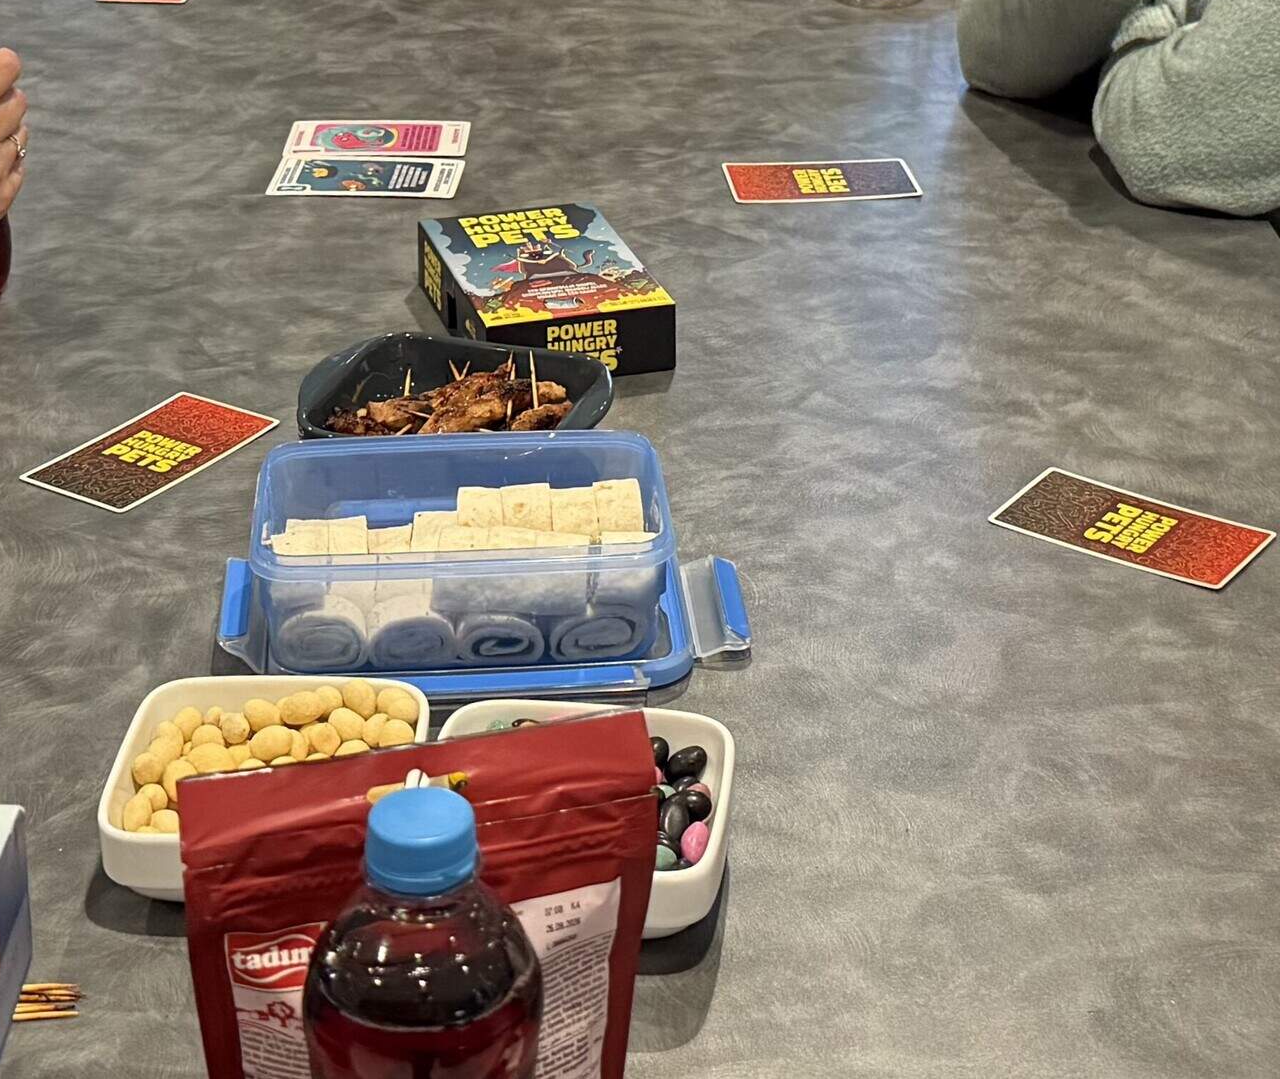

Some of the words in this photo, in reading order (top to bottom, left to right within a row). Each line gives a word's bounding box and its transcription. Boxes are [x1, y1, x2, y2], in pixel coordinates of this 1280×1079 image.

[458, 207, 565, 228] POWER
[464, 215, 568, 236] HUNGRY
[470, 224, 581, 249] PETS
[547, 319, 618, 342] POWER
[547, 335, 618, 353] HUNGRY
[120, 437, 192, 462] HUNGRY
[133, 430, 203, 457] POWER
[101, 443, 179, 473] PETS
[1083, 503, 1144, 544] PETS
[1110, 511, 1161, 550] HUNGRY
[1125, 515, 1179, 554] POWER
